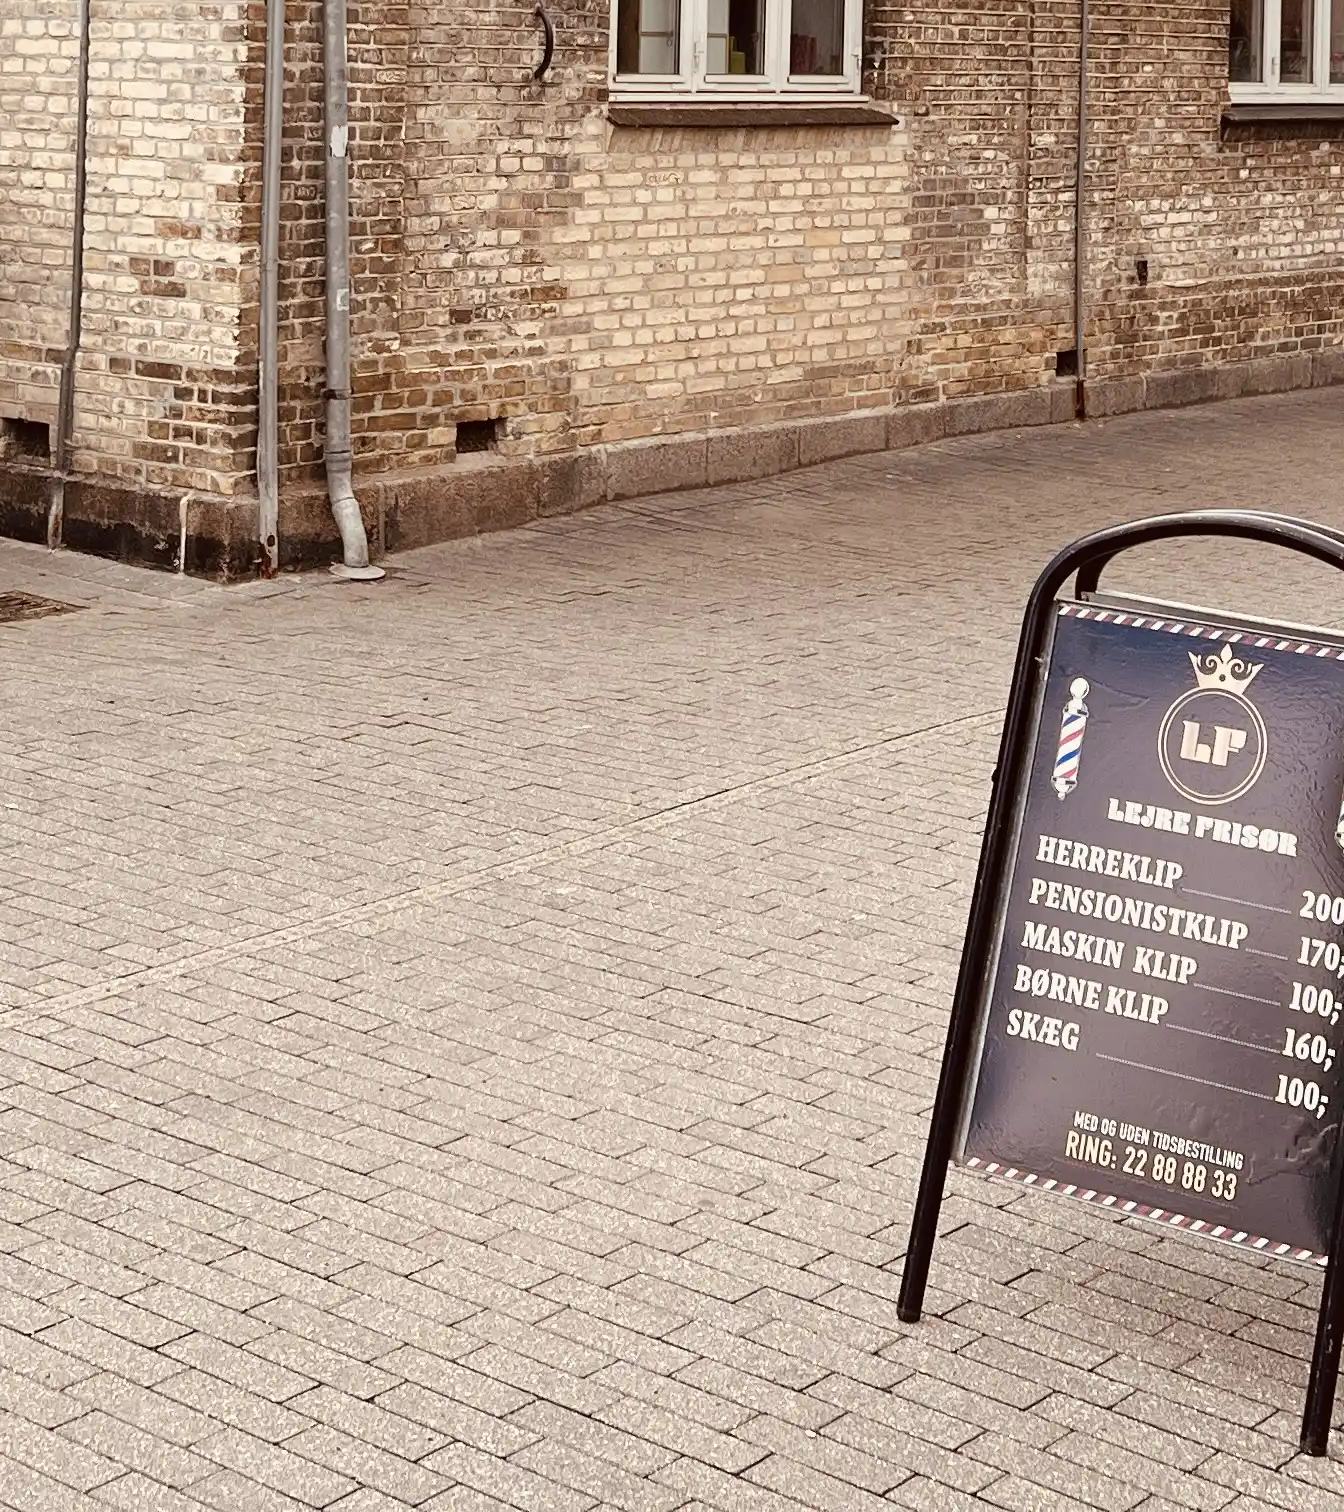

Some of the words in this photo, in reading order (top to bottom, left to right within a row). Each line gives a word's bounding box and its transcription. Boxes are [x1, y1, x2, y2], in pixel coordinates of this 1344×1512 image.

[1107, 797, 1192, 835] LEJRE
[1035, 834, 1183, 889] HERREKLIP
[1028, 877, 1249, 950] PENSIONISTKLIP
[1020, 920, 1126, 969] MASKIN
[1132, 945, 1198, 985] KLIP
[1013, 963, 1103, 1011] BØRNE
[1104, 985, 1169, 1025] KLIP
[1006, 1008, 1081, 1052] SKÆG
[1064, 1130, 1118, 1170] RING:
[1122, 1145, 1148, 1177] 22
[1151, 1153, 1177, 1185] 88
[1181, 1161, 1207, 1193] 88
[1210, 1169, 1238, 1201] 33
[1073, 1110, 1099, 1132] MED
[1100, 1118, 1118, 1138] OG
[1119, 1122, 1151, 1146] UDEN
[1152, 1130, 1244, 1171] TIDSBESTILLING
